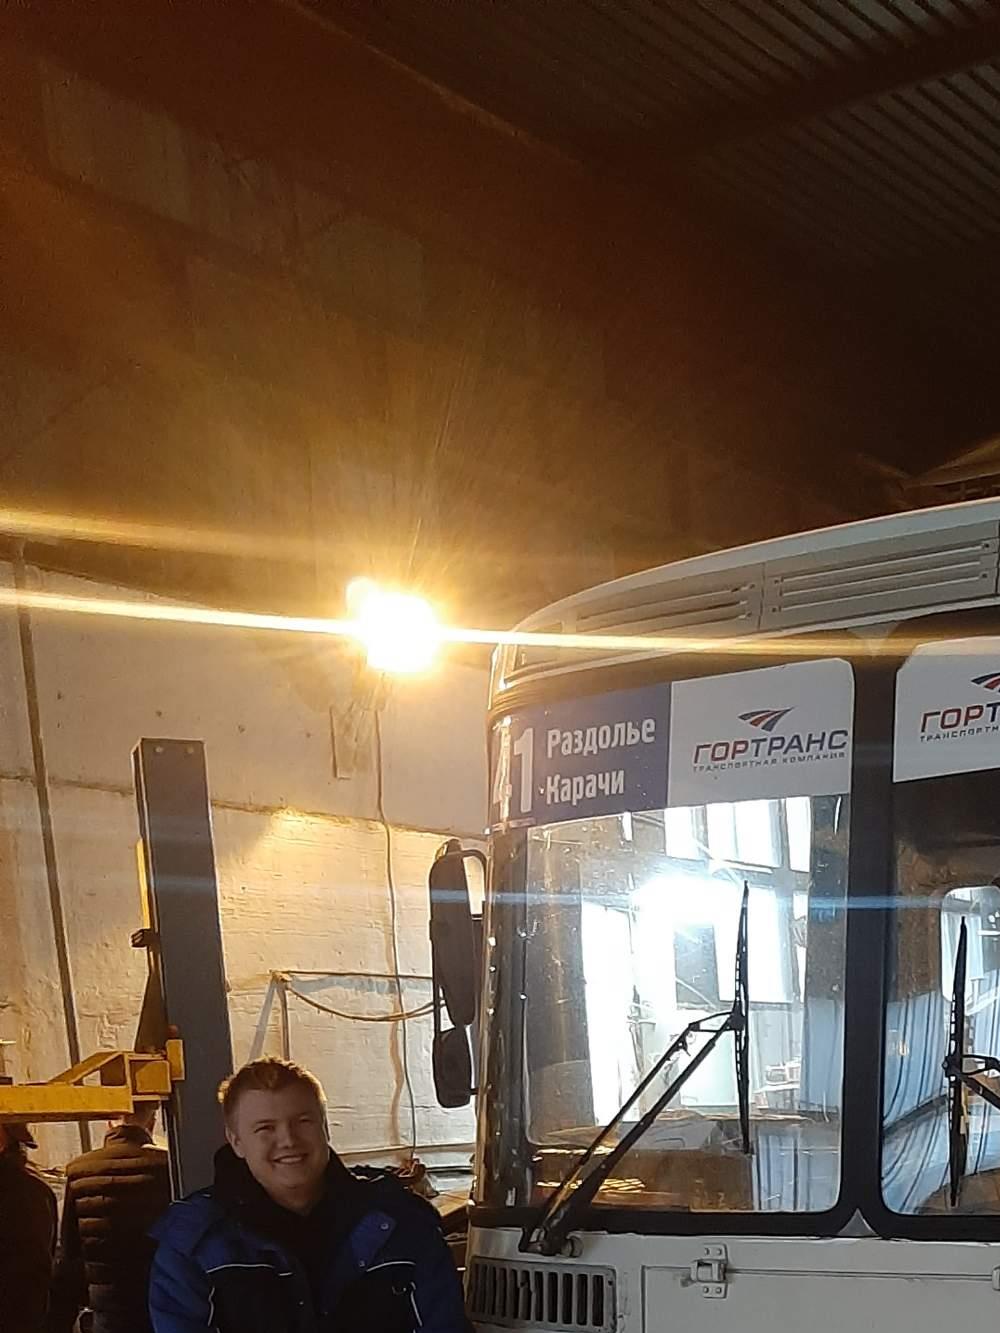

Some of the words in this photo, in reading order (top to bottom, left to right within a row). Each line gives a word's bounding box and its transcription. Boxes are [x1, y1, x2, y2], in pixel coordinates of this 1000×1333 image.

[546, 718, 656, 759] Раздолье
[693, 729, 850, 764] ГОРТРАНС
[693, 758, 777, 773] ТРАНСПОРТНАЯ
[782, 751, 846, 765] КОМПАНИЯ
[546, 769, 625, 806] Карачи
